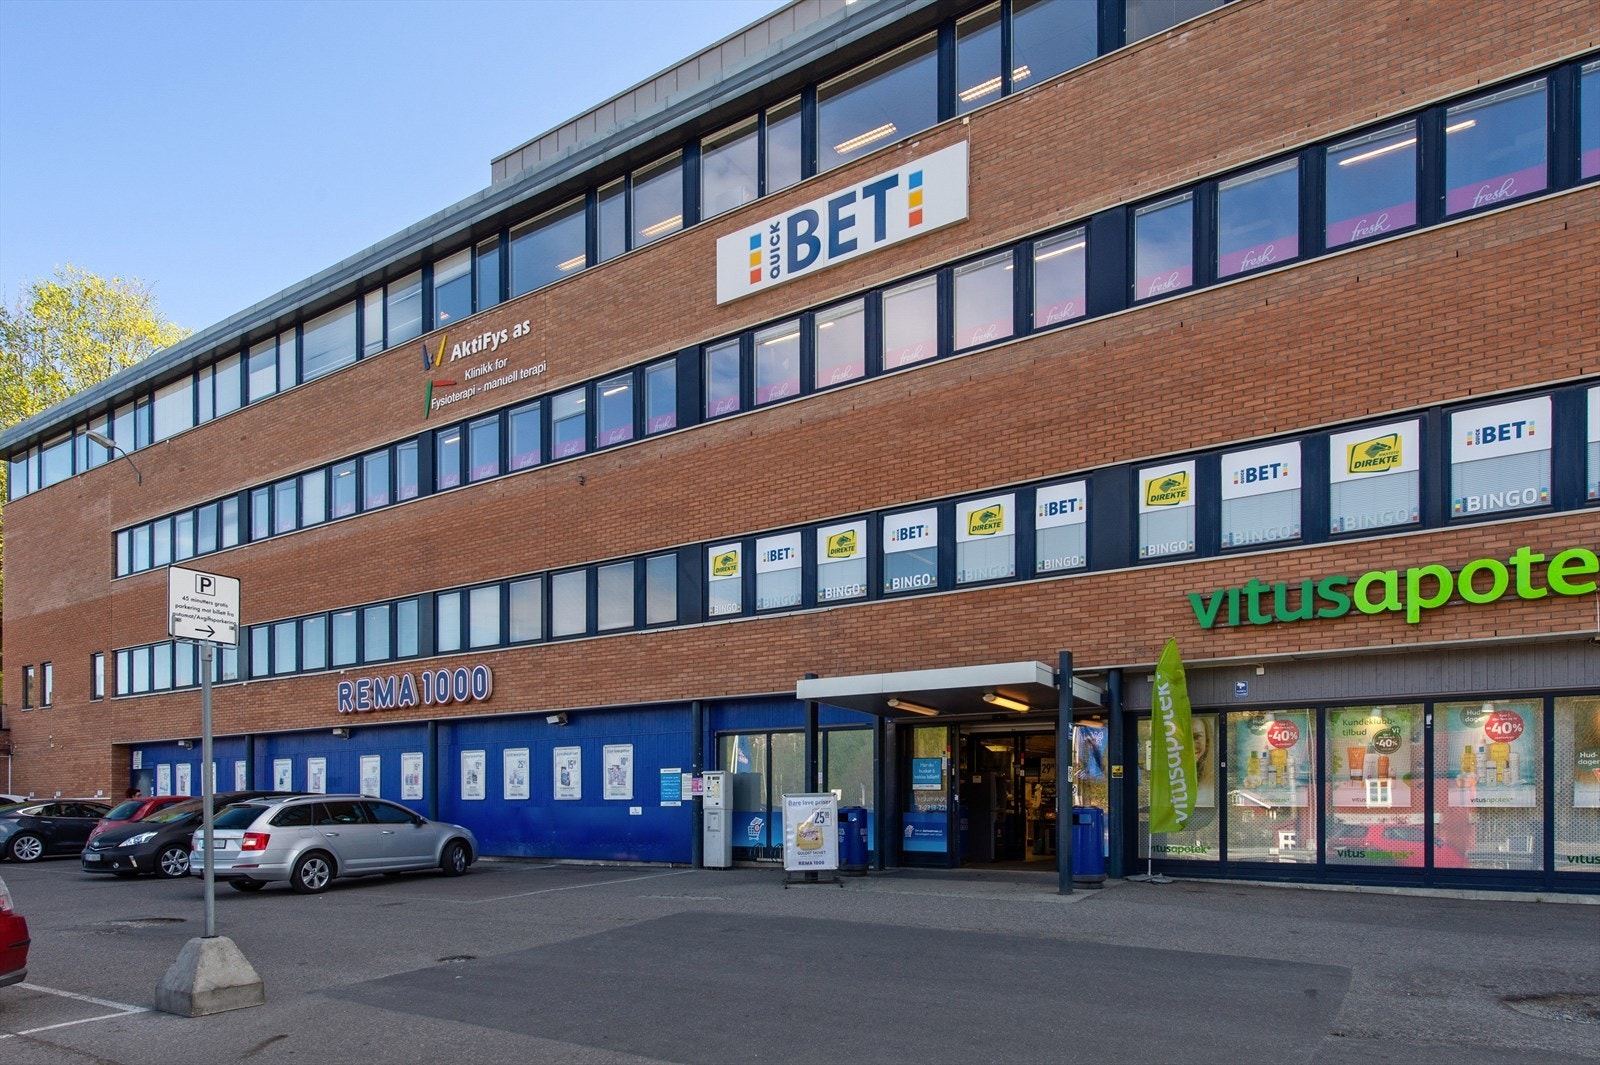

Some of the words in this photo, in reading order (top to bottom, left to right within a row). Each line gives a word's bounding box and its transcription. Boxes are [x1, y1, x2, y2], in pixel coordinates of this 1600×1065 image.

[1473, 178, 1517, 208] fresh
[787, 173, 899, 274] BET
[1351, 213, 1391, 241] fresh
[770, 221, 780, 279] QUICK
[1240, 244, 1276, 271] fresh
[1148, 271, 1181, 296] fresh
[1045, 302, 1075, 325] fresh
[451, 329, 508, 361] AktiFys
[513, 320, 530, 338] as
[971, 324, 998, 344] fresh
[464, 363, 493, 380] Klinikk
[495, 358, 508, 369] for
[431, 385, 476, 410] Fysioterapi
[484, 371, 517, 391] manuell
[520, 361, 547, 380] terapi
[1482, 421, 1526, 444] BET
[1354, 455, 1398, 469] DIREKTE
[1246, 463, 1281, 483] BET
[1150, 490, 1186, 502] DIREKTE
[1467, 487, 1537, 512] BINGO
[1049, 498, 1077, 515] BET
[972, 521, 1001, 532] DIREKTE
[1347, 508, 1408, 530] BINGO
[900, 525, 924, 541] BET
[1232, 525, 1291, 545] BINGO
[770, 547, 790, 562] BET
[830, 545, 855, 555] DIREKTE
[1148, 540, 1187, 555] BINGO
[715, 564, 737, 573] DIREKTE
[1044, 556, 1079, 570] BINGO
[965, 564, 1009, 580] BINGO
[200, 577, 212, 592] P
[892, 573, 930, 590] BINGO
[825, 583, 860, 599] BINGO
[175, 604, 200, 612] parkering
[715, 603, 737, 614] BINGO
[338, 672, 420, 713] REMA
[422, 664, 492, 704] 1000
[1342, 718, 1395, 726] Kundeklubb-
[1486, 722, 1523, 734] -40%
[1268, 730, 1298, 741] -40%
[1342, 728, 1367, 736] tilbud
[1375, 739, 1398, 747] -40%
[1041, 763, 1050, 773] 29
[1577, 759, 1600, 767] dager
[814, 811, 825, 824] 25
